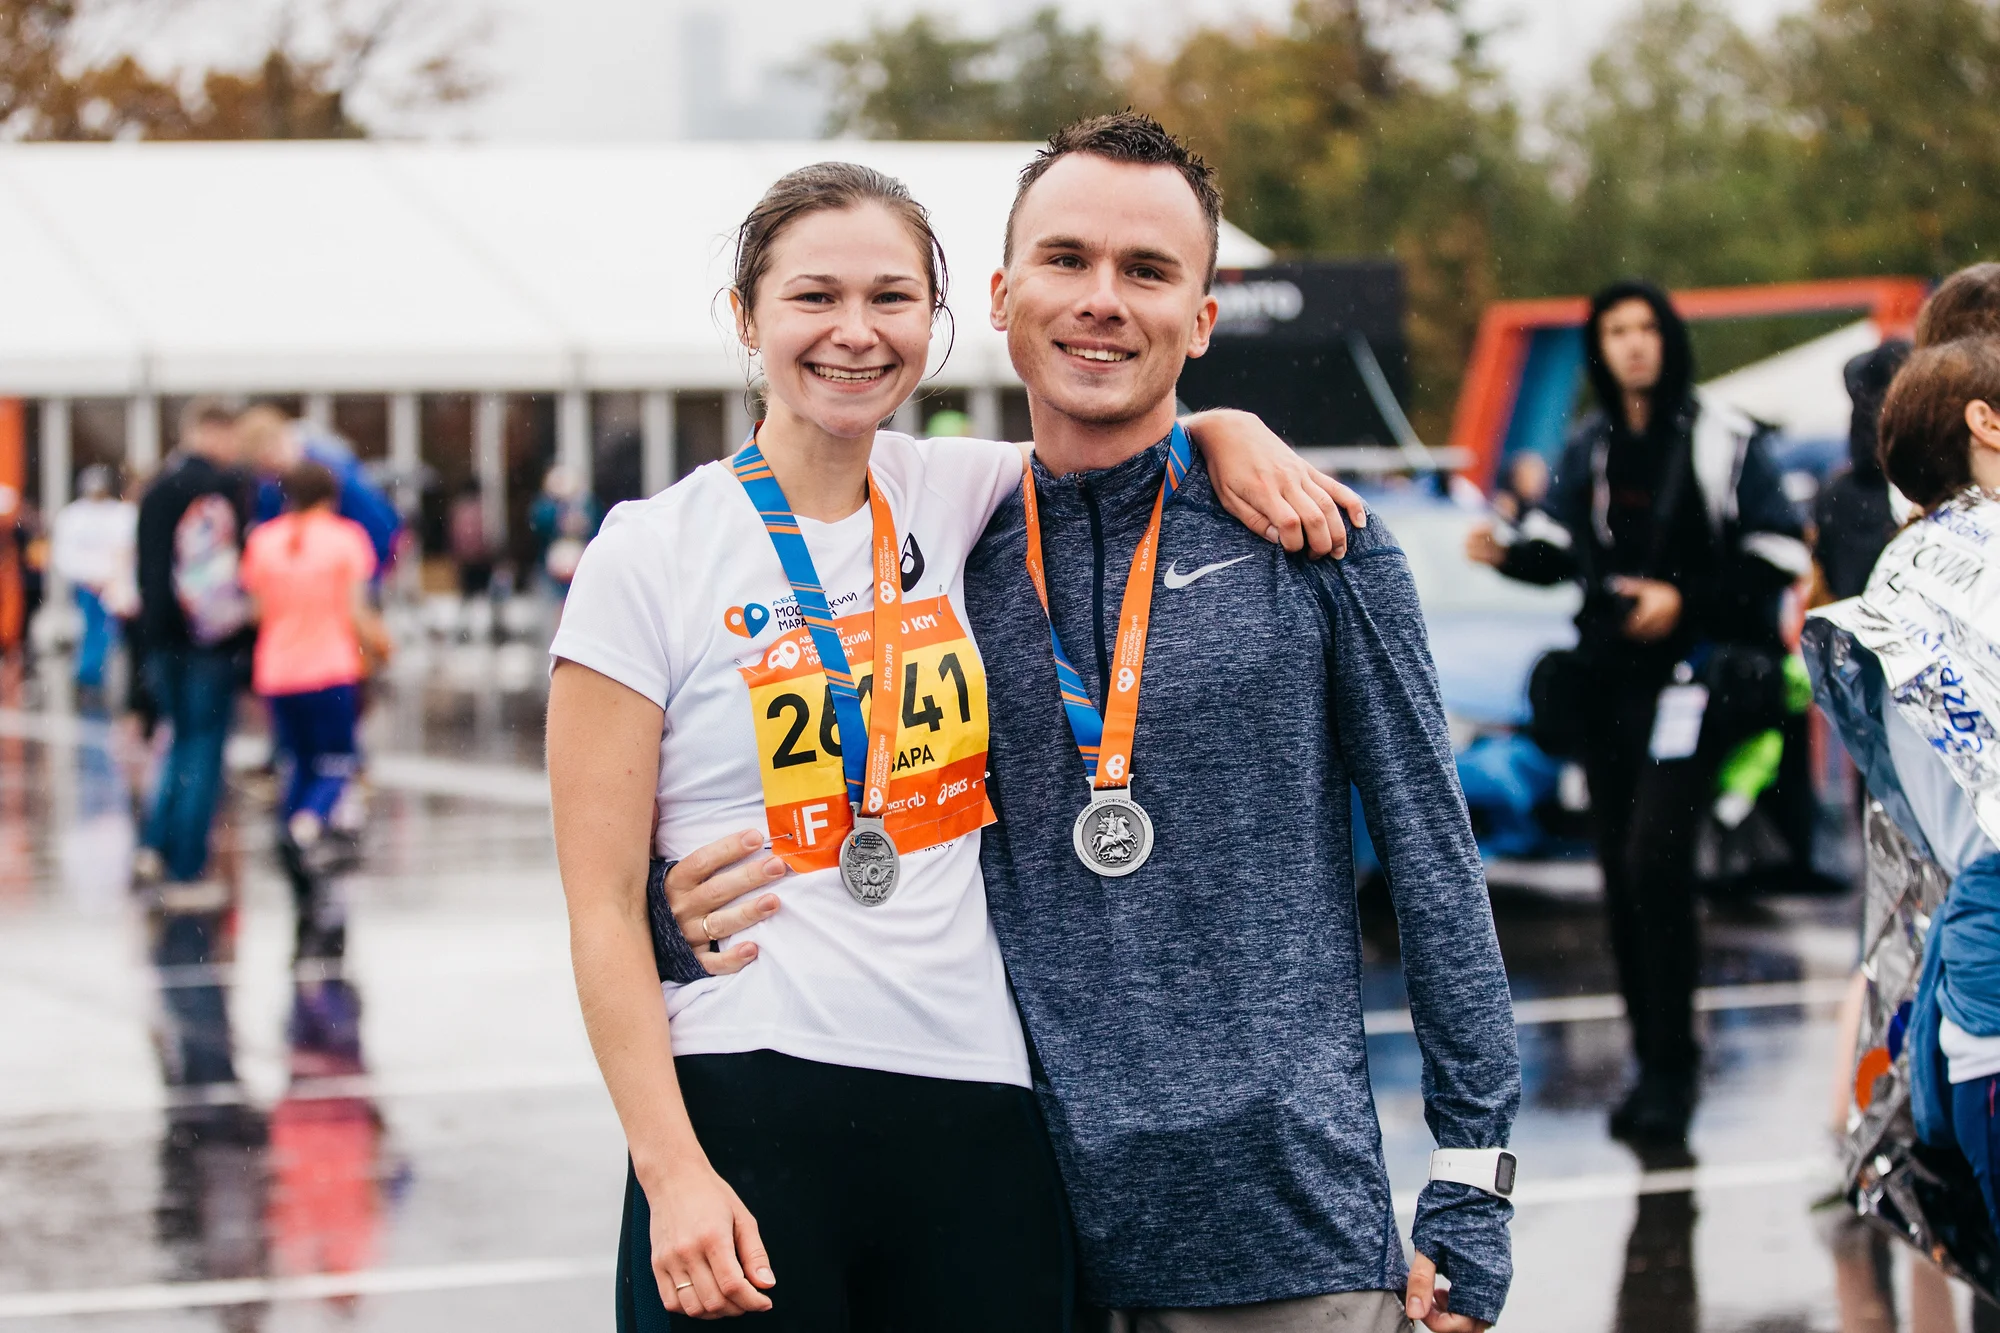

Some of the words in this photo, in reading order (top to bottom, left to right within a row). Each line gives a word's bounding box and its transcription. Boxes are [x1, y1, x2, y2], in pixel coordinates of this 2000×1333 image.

[883, 535, 892, 581] МОСКОВСКИЙ
[1126, 614, 1138, 666] МОСКОВСКИЙ
[1132, 629, 1143, 667] МАРАФОН
[883, 644, 893, 692] 23.09.2018
[876, 734, 886, 787] МОСКОВСКИЙ
[881, 750, 890, 789] МАРАФОН
[948, 778, 968, 798] asics
[801, 803, 828, 846] F
[1095, 798, 1129, 807] МОСКОВСКИЙ
[1129, 803, 1148, 822] МАРАФОН
